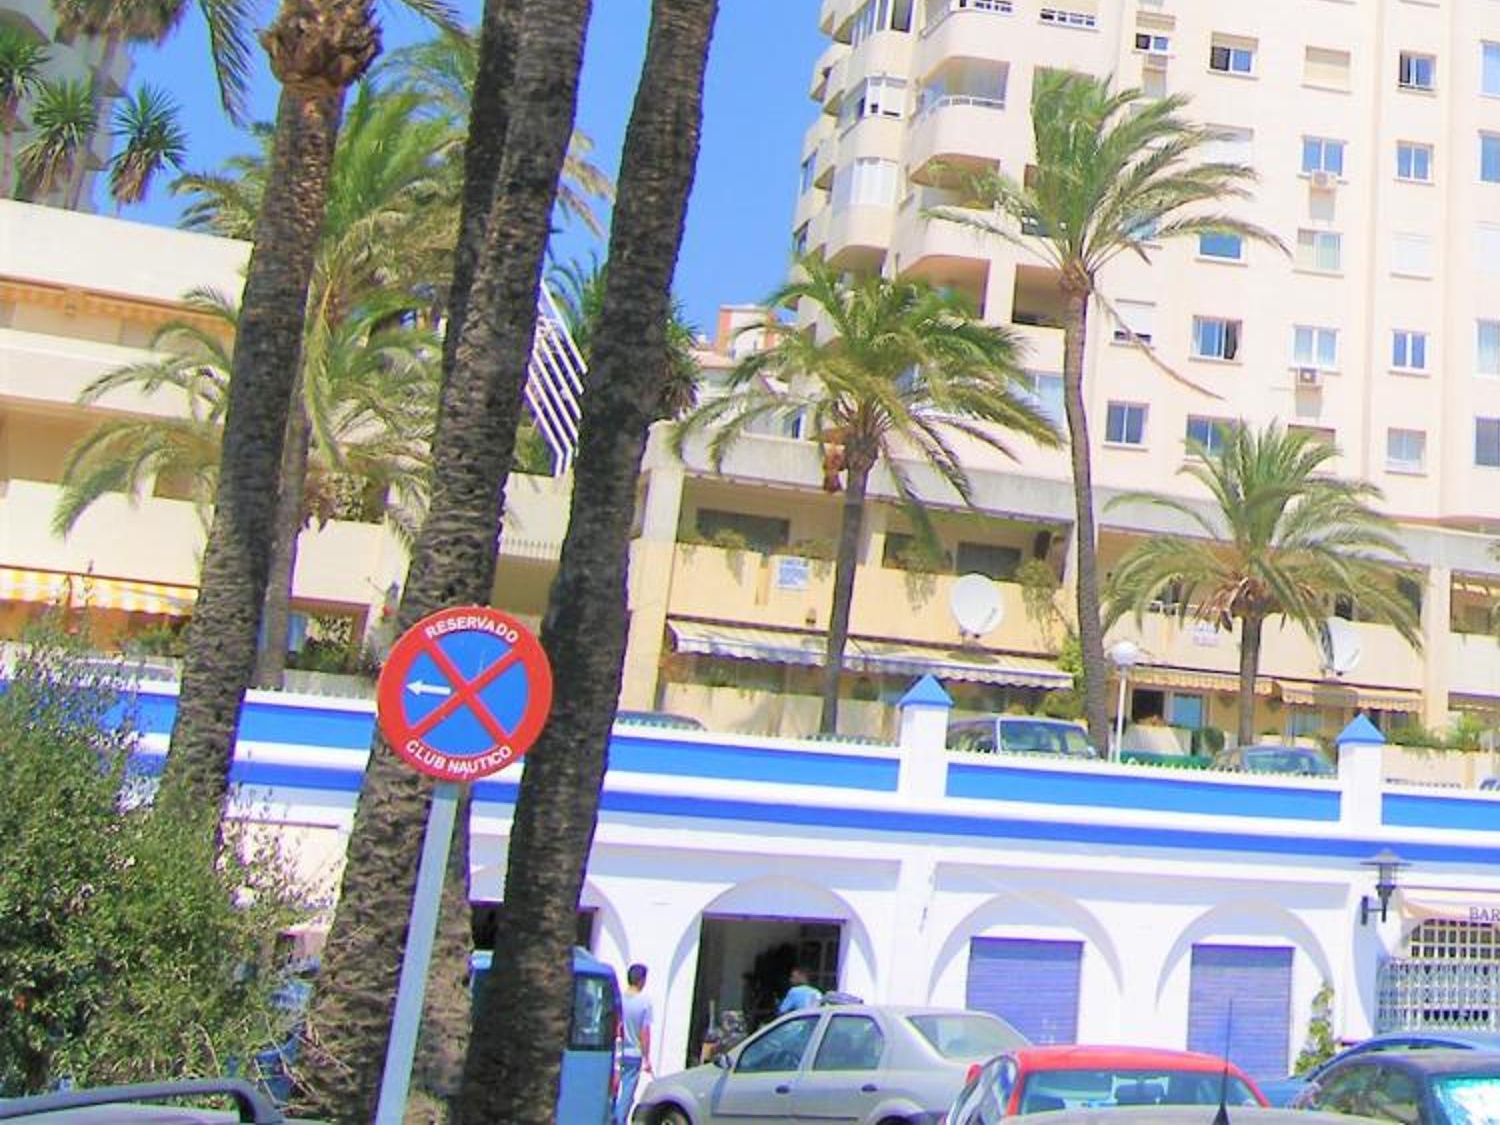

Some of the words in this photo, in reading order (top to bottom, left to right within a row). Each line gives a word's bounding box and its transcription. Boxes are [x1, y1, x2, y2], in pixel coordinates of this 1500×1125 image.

[424, 615, 519, 644] RESERVADO
[405, 739, 446, 770] CLUB
[448, 744, 513, 773] NAUTICO
